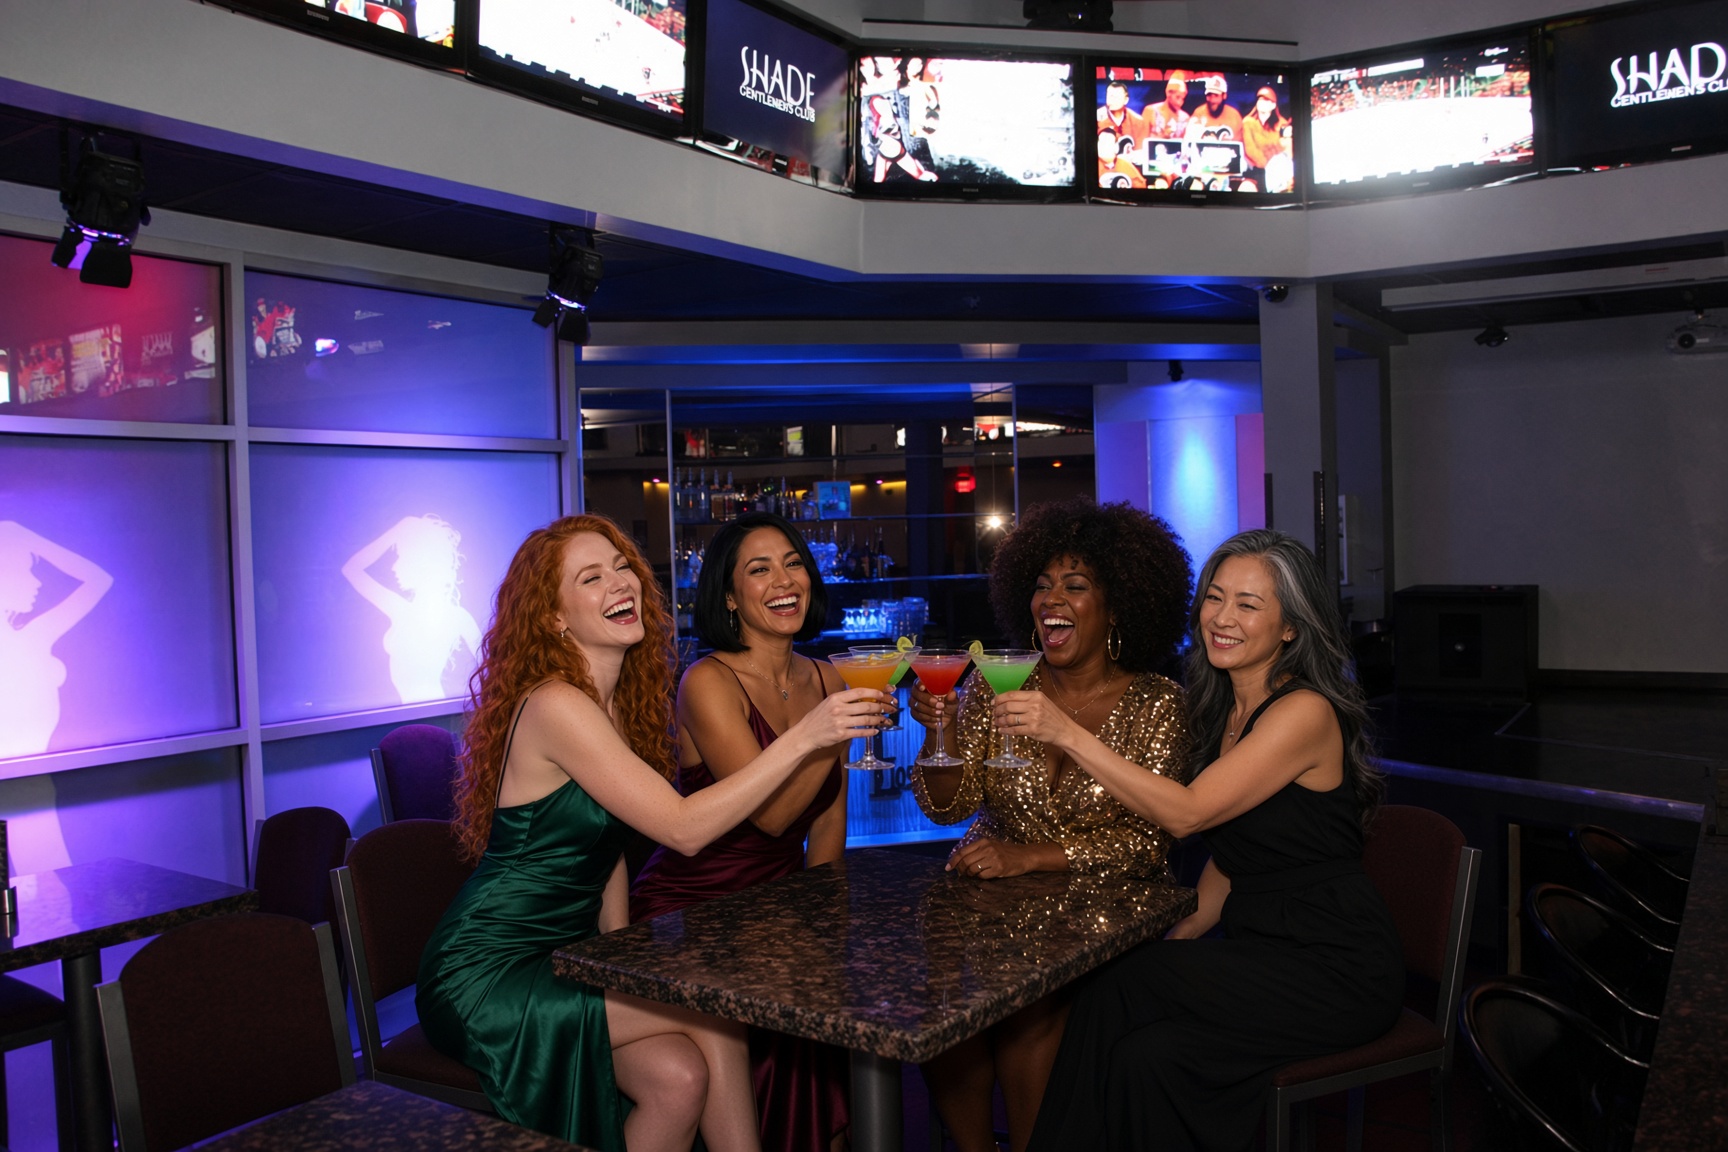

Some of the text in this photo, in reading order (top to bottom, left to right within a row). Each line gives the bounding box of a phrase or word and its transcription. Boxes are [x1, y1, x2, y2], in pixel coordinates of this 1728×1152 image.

[740, 46, 816, 111] SHADE
[1707, 78, 1728, 93] CL
[794, 106, 816, 123] CLUB
